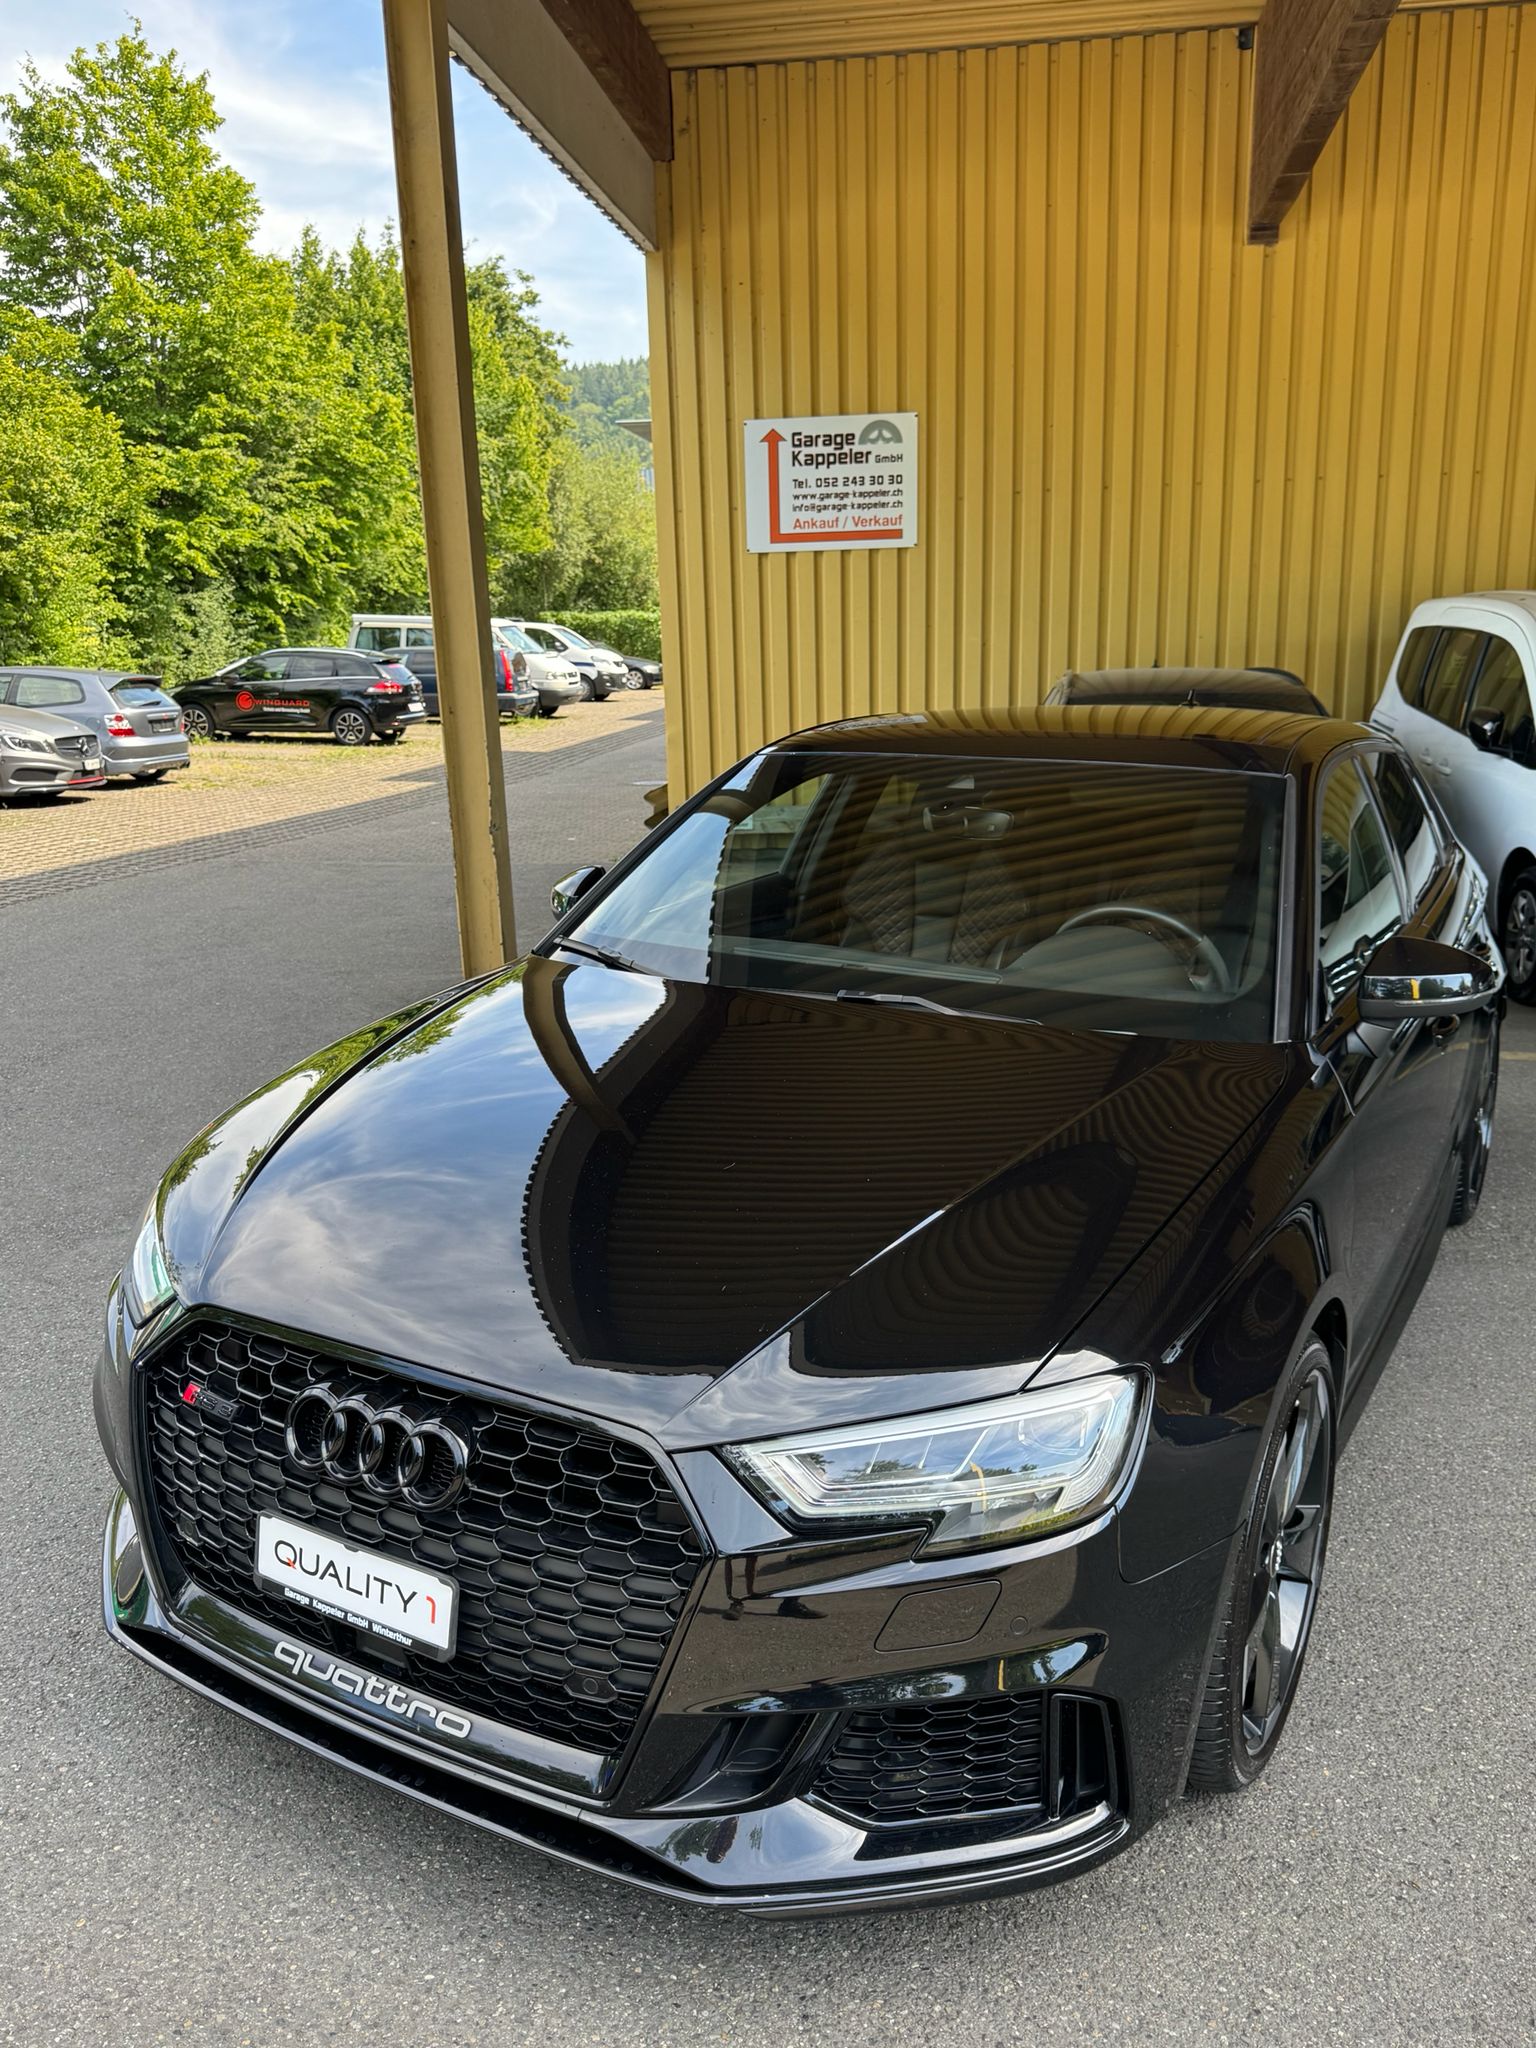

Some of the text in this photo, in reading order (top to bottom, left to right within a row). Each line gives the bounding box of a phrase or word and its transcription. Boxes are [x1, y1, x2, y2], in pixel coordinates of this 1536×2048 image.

[791, 431, 856, 450] Garage
[791, 449, 904, 469] Kappeler GmbH
[792, 473, 904, 489] Tel. 052 243 30 30
[792, 487, 904, 501] www.garage-kappeler.ch
[792, 499, 904, 513] info@garage-kappeler.ch
[793, 513, 904, 530] Ankauf / Verkauf
[284, 1587, 413, 1647] Garage Kappeler GmbH Winterthur
[273, 1640, 472, 1739] quattro
